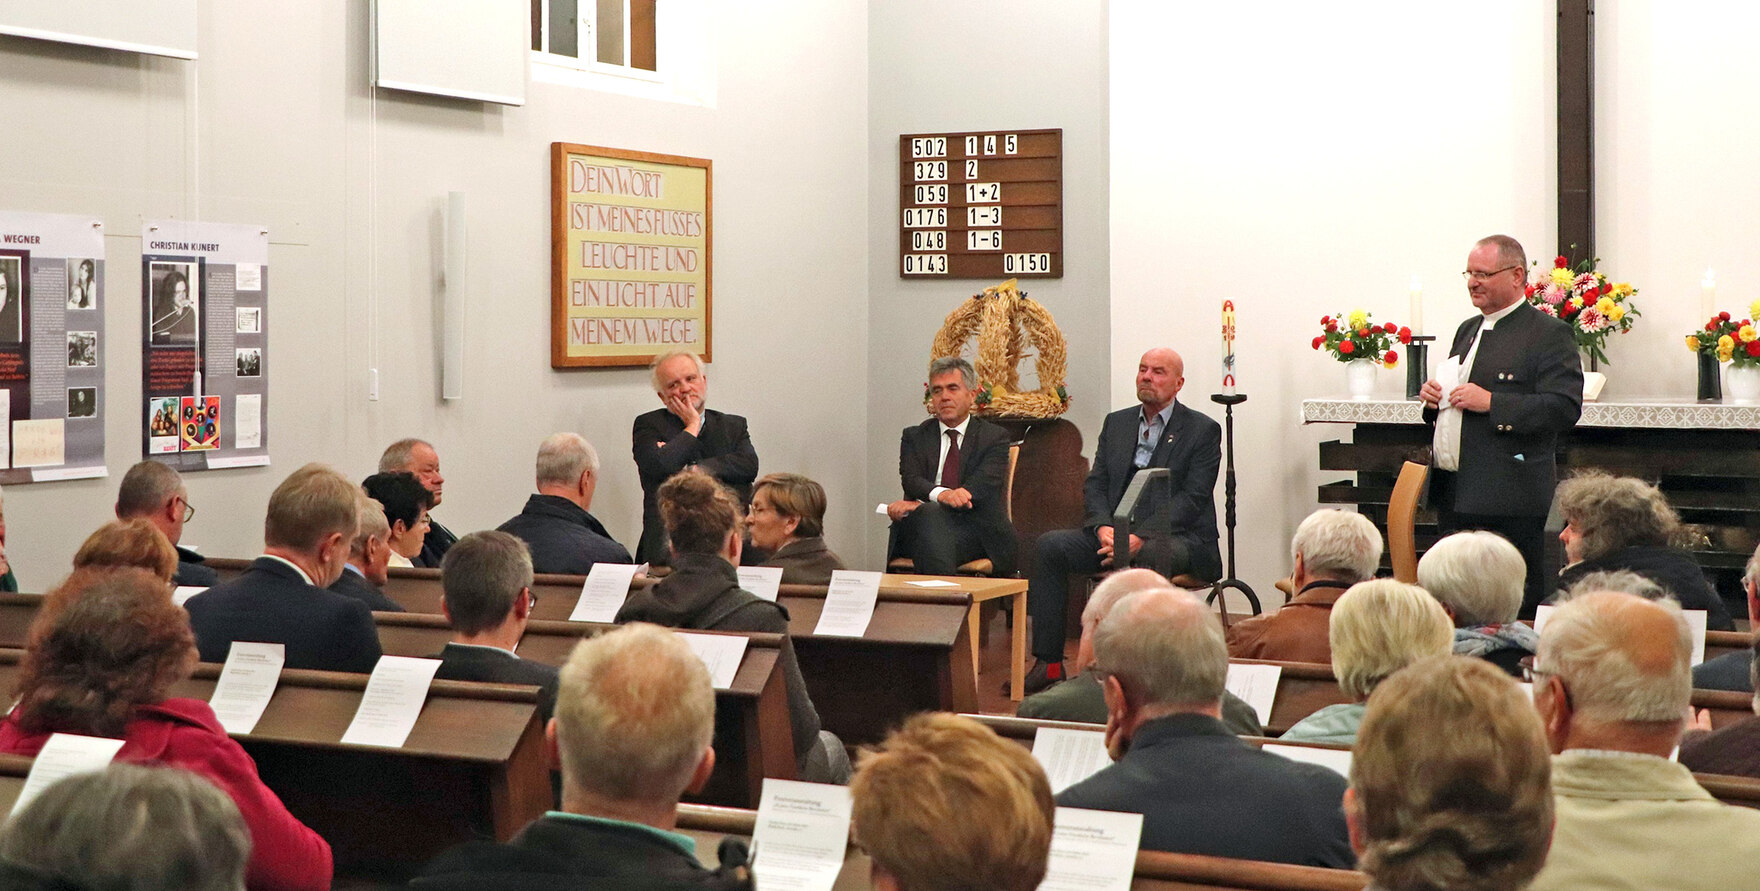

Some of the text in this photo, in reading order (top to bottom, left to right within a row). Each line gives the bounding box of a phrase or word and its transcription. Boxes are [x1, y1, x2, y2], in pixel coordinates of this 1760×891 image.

[914, 135, 1015, 156] 502 1 4 5
[570, 160, 662, 198] DEIN WORT
[916, 161, 975, 179] 329 2
[917, 184, 998, 202] 059 1+2
[570, 203, 702, 238] IST MEINES FUSSES
[906, 209, 945, 225] 0176
[3, 234, 41, 244] WEGNER
[150, 241, 189, 250] CHRISTIAN
[914, 232, 944, 248] 048
[581, 242, 698, 272] LEUCHTE UND
[906, 254, 1048, 272] 0143 0150
[572, 280, 696, 309] EIN LICHT AUF
[571, 319, 697, 345] MEINEM WEGE.
